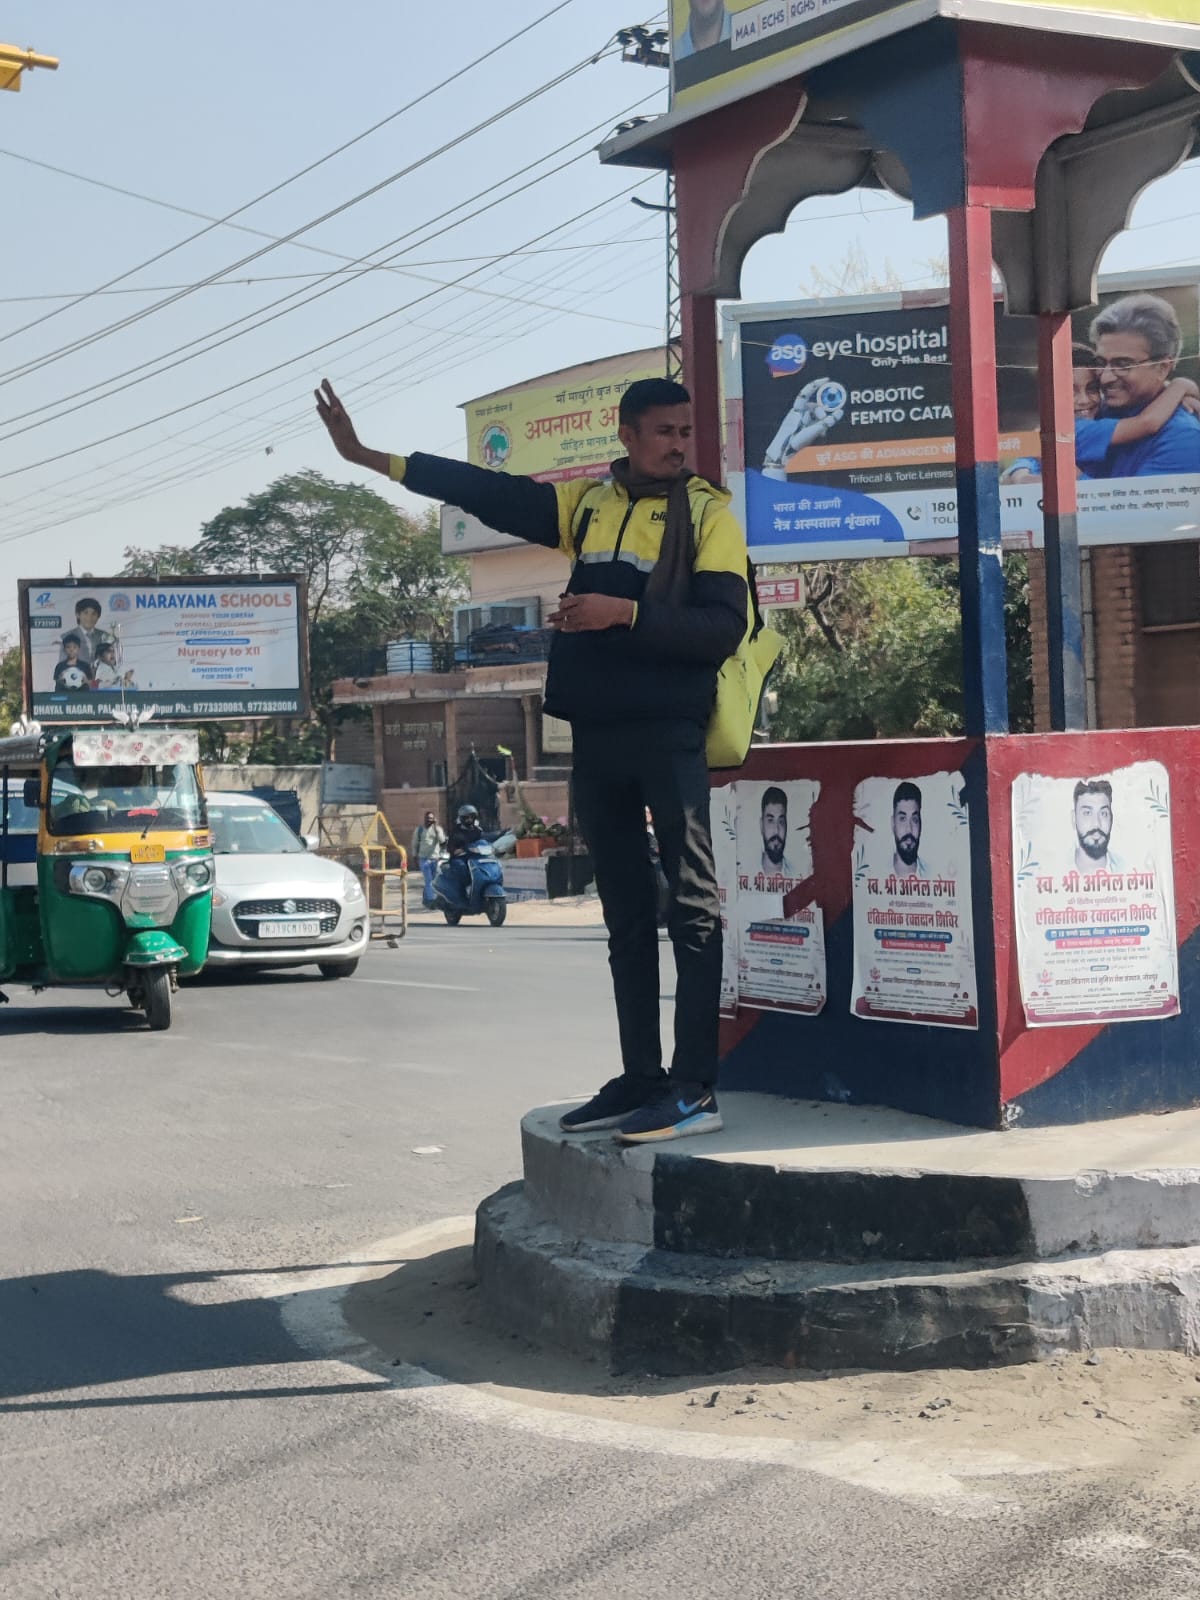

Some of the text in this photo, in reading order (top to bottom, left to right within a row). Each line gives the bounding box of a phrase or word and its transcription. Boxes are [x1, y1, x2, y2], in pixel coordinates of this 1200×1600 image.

[735, 21, 756, 41] MAA
[762, 9, 785, 30] ECHS
[771, 326, 948, 364] asg eye hospital
[872, 356, 898, 368] Only
[924, 353, 947, 363] Best
[850, 386, 925, 404] ROBOTIC
[525, 410, 593, 440] अपनाघर
[850, 408, 906, 425] FEMTO
[848, 470, 954, 484] Trifocal & Toric Lenses
[773, 502, 796, 512] भारत
[798, 498, 811, 511] की
[773, 517, 791, 531] नेत्र
[794, 516, 841, 530] अस्पताल
[135, 592, 292, 609] NARAYANA SCHOOLS
[178, 646, 261, 659] Nursery to XII
[754, 872, 765, 892] श्री
[766, 872, 793, 893] अनिल
[868, 873, 955, 898] स्व. श्री अनिल लेगा
[1036, 868, 1154, 894] स्व. श्री अनिल लेगा
[1036, 904, 1157, 925] ऐतिहासिक रक्तदान शिविर
